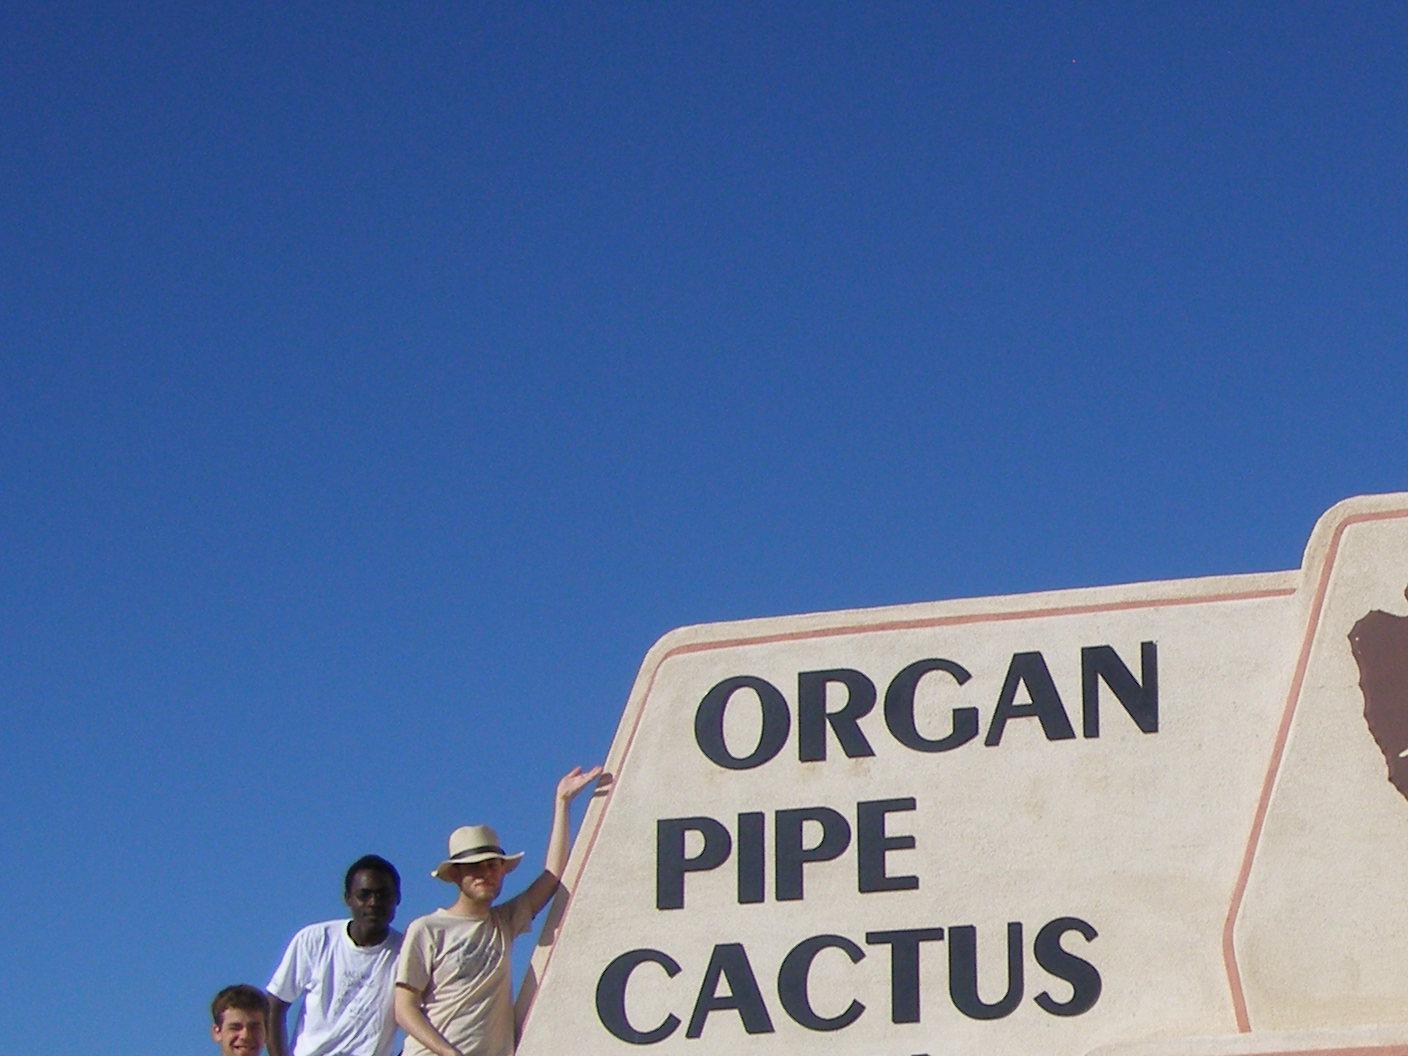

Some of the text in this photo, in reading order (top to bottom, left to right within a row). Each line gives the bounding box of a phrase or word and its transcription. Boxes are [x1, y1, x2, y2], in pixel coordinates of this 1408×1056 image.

[694, 640, 1159, 770] ORGAN
[656, 797, 920, 910] PIPE
[595, 917, 1102, 1045] CACTUS
